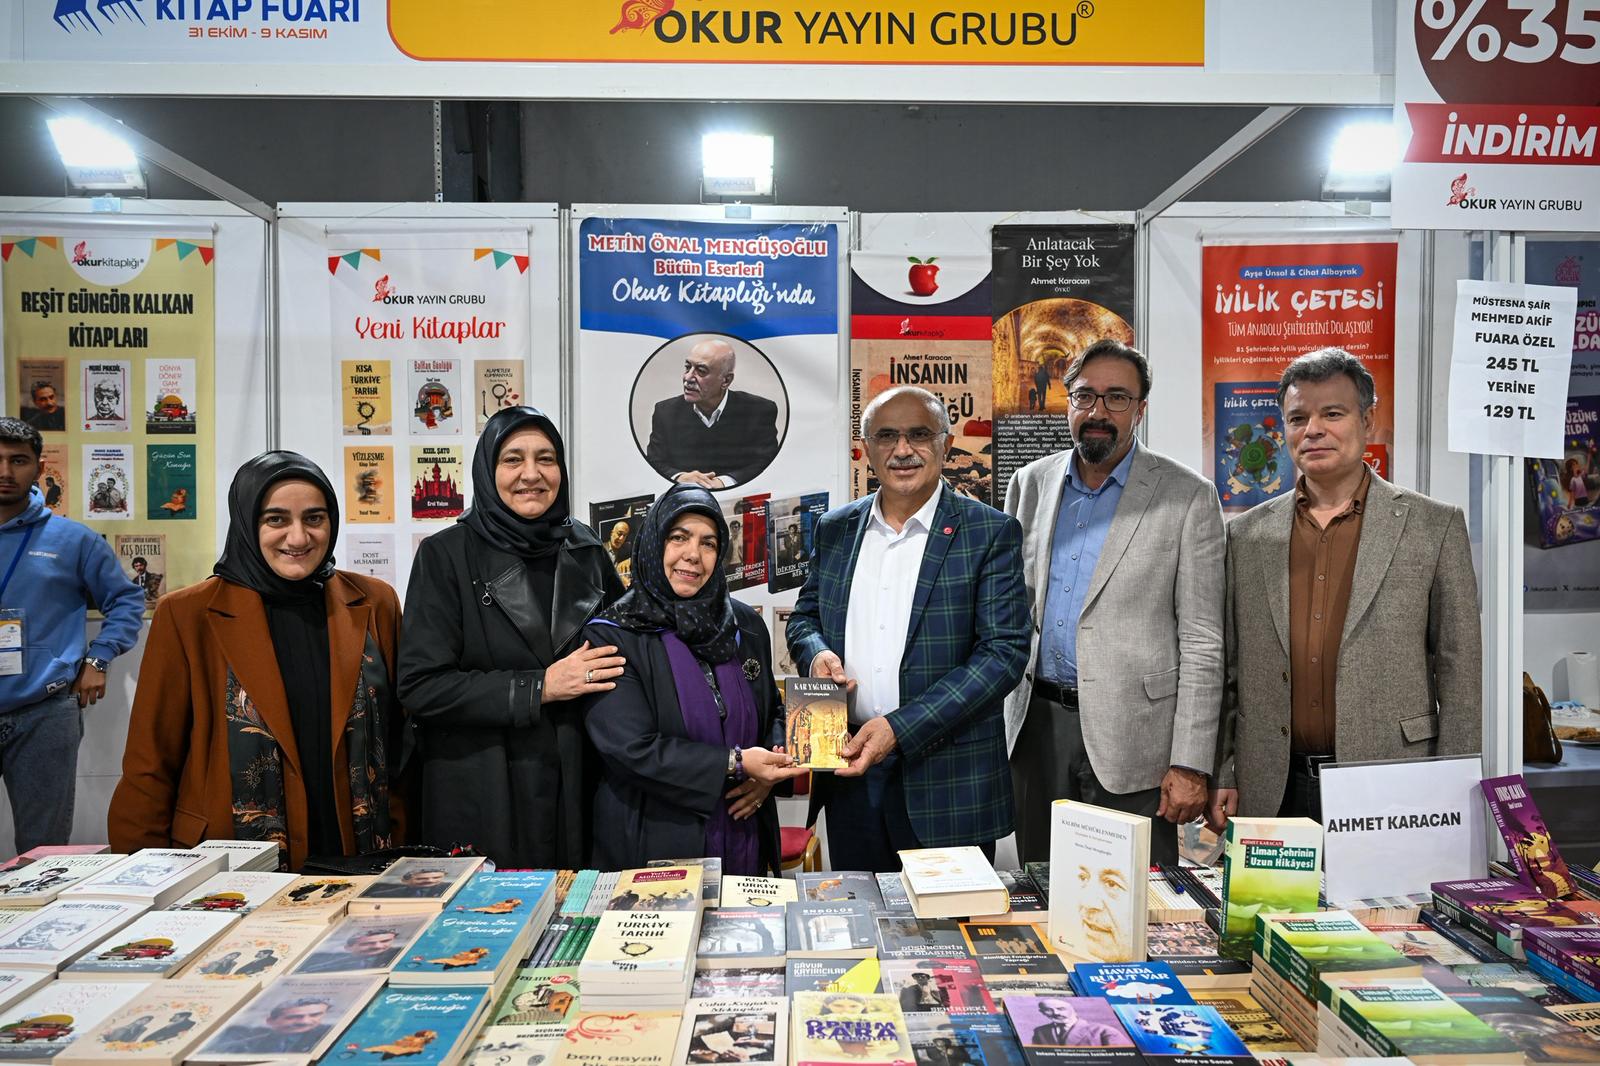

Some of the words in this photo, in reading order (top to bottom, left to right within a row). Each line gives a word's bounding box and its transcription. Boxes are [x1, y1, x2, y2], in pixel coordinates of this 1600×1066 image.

[188, 28, 203, 38] 31
[207, 26, 248, 38] EKİM
[260, 28, 272, 39] 9
[275, 28, 328, 39] KASIM
[654, 10, 783, 44] OKUR
[800, 12, 916, 45] YAYIN
[1442, 112, 1598, 157] İNDİRİM
[1459, 199, 1497, 210] OKUR
[1499, 199, 1536, 211] YAYIN
[1538, 199, 1583, 211] GRUBU
[588, 233, 646, 253] METİN
[650, 234, 701, 254] ÖNAL
[703, 236, 828, 259] MENGÜŞOĞLU
[1026, 237, 1095, 251] Anlatacak
[654, 258, 701, 276] Bütün
[704, 260, 764, 278] Eserleri
[1022, 255, 1042, 268] Bir
[1046, 254, 1071, 271] Şey
[1074, 254, 1100, 268] Yok
[1244, 269, 1263, 277] Ayşe
[1265, 267, 1288, 277] Ünsal
[1298, 268, 1319, 276] Cihat
[1321, 267, 1358, 277] Albayrak
[1031, 277, 1057, 285] Ahmet
[1058, 277, 1090, 285] Karacan
[21, 288, 65, 318] REŞİT
[68, 288, 131, 314] GÜNGÖR
[133, 294, 194, 314] KALKAN
[383, 295, 415, 305] OKUR
[416, 295, 447, 305] YAYIN
[449, 294, 486, 305] GRUBU
[612, 278, 672, 302] Okur
[678, 279, 815, 314] Kitaplığı'nda
[1214, 283, 1280, 314] İYİLİK
[1290, 280, 1384, 318] ÇETESİ
[1472, 296, 1526, 308] MÜSTESNA
[1528, 299, 1551, 310] ŞAİR
[1471, 312, 1524, 325] MEHMED
[1526, 314, 1553, 327] AKİF
[69, 322, 148, 348] KİTAPLARI
[355, 316, 405, 340] Yeni
[412, 316, 506, 344] Kitaplar
[1228, 321, 1246, 337] TÜM
[1247, 321, 1282, 337] ANADOLU
[1283, 320, 1329, 340] ŞEHİRLERİNİ
[1330, 319, 1374, 339] DOLAŞIYOR!
[1475, 332, 1520, 345] FUARA
[1522, 333, 1556, 348] ÖZEL
[1246, 345, 1280, 353] Şehrimizde
[355, 364, 373, 373] KISA
[889, 357, 968, 384] İNSANIN
[1486, 356, 1518, 371] 245
[1522, 358, 1540, 373] TL
[350, 375, 381, 384] TÜRKİYE
[1487, 379, 1536, 394] YERİNE
[1224, 396, 1248, 408] İYİLİK
[1484, 404, 1514, 418] 129
[1518, 406, 1536, 420] TL
[352, 451, 385, 461] YÜZLEŞME
[794, 683, 807, 691] KAR
[1327, 816, 1384, 833] AHMET
[1387, 811, 1462, 831] KARACAN
[1251, 846, 1277, 856] Liman
[1279, 847, 1314, 858] Şehrinin
[1250, 857, 1273, 866] Uzun
[1275, 858, 1314, 869] Hikâyesi
[1089, 974, 1141, 982] BULUT
[1098, 967, 1154, 975] HAVADA
[565, 1053, 601, 1062] ben
[607, 1053, 663, 1063] asyalı
